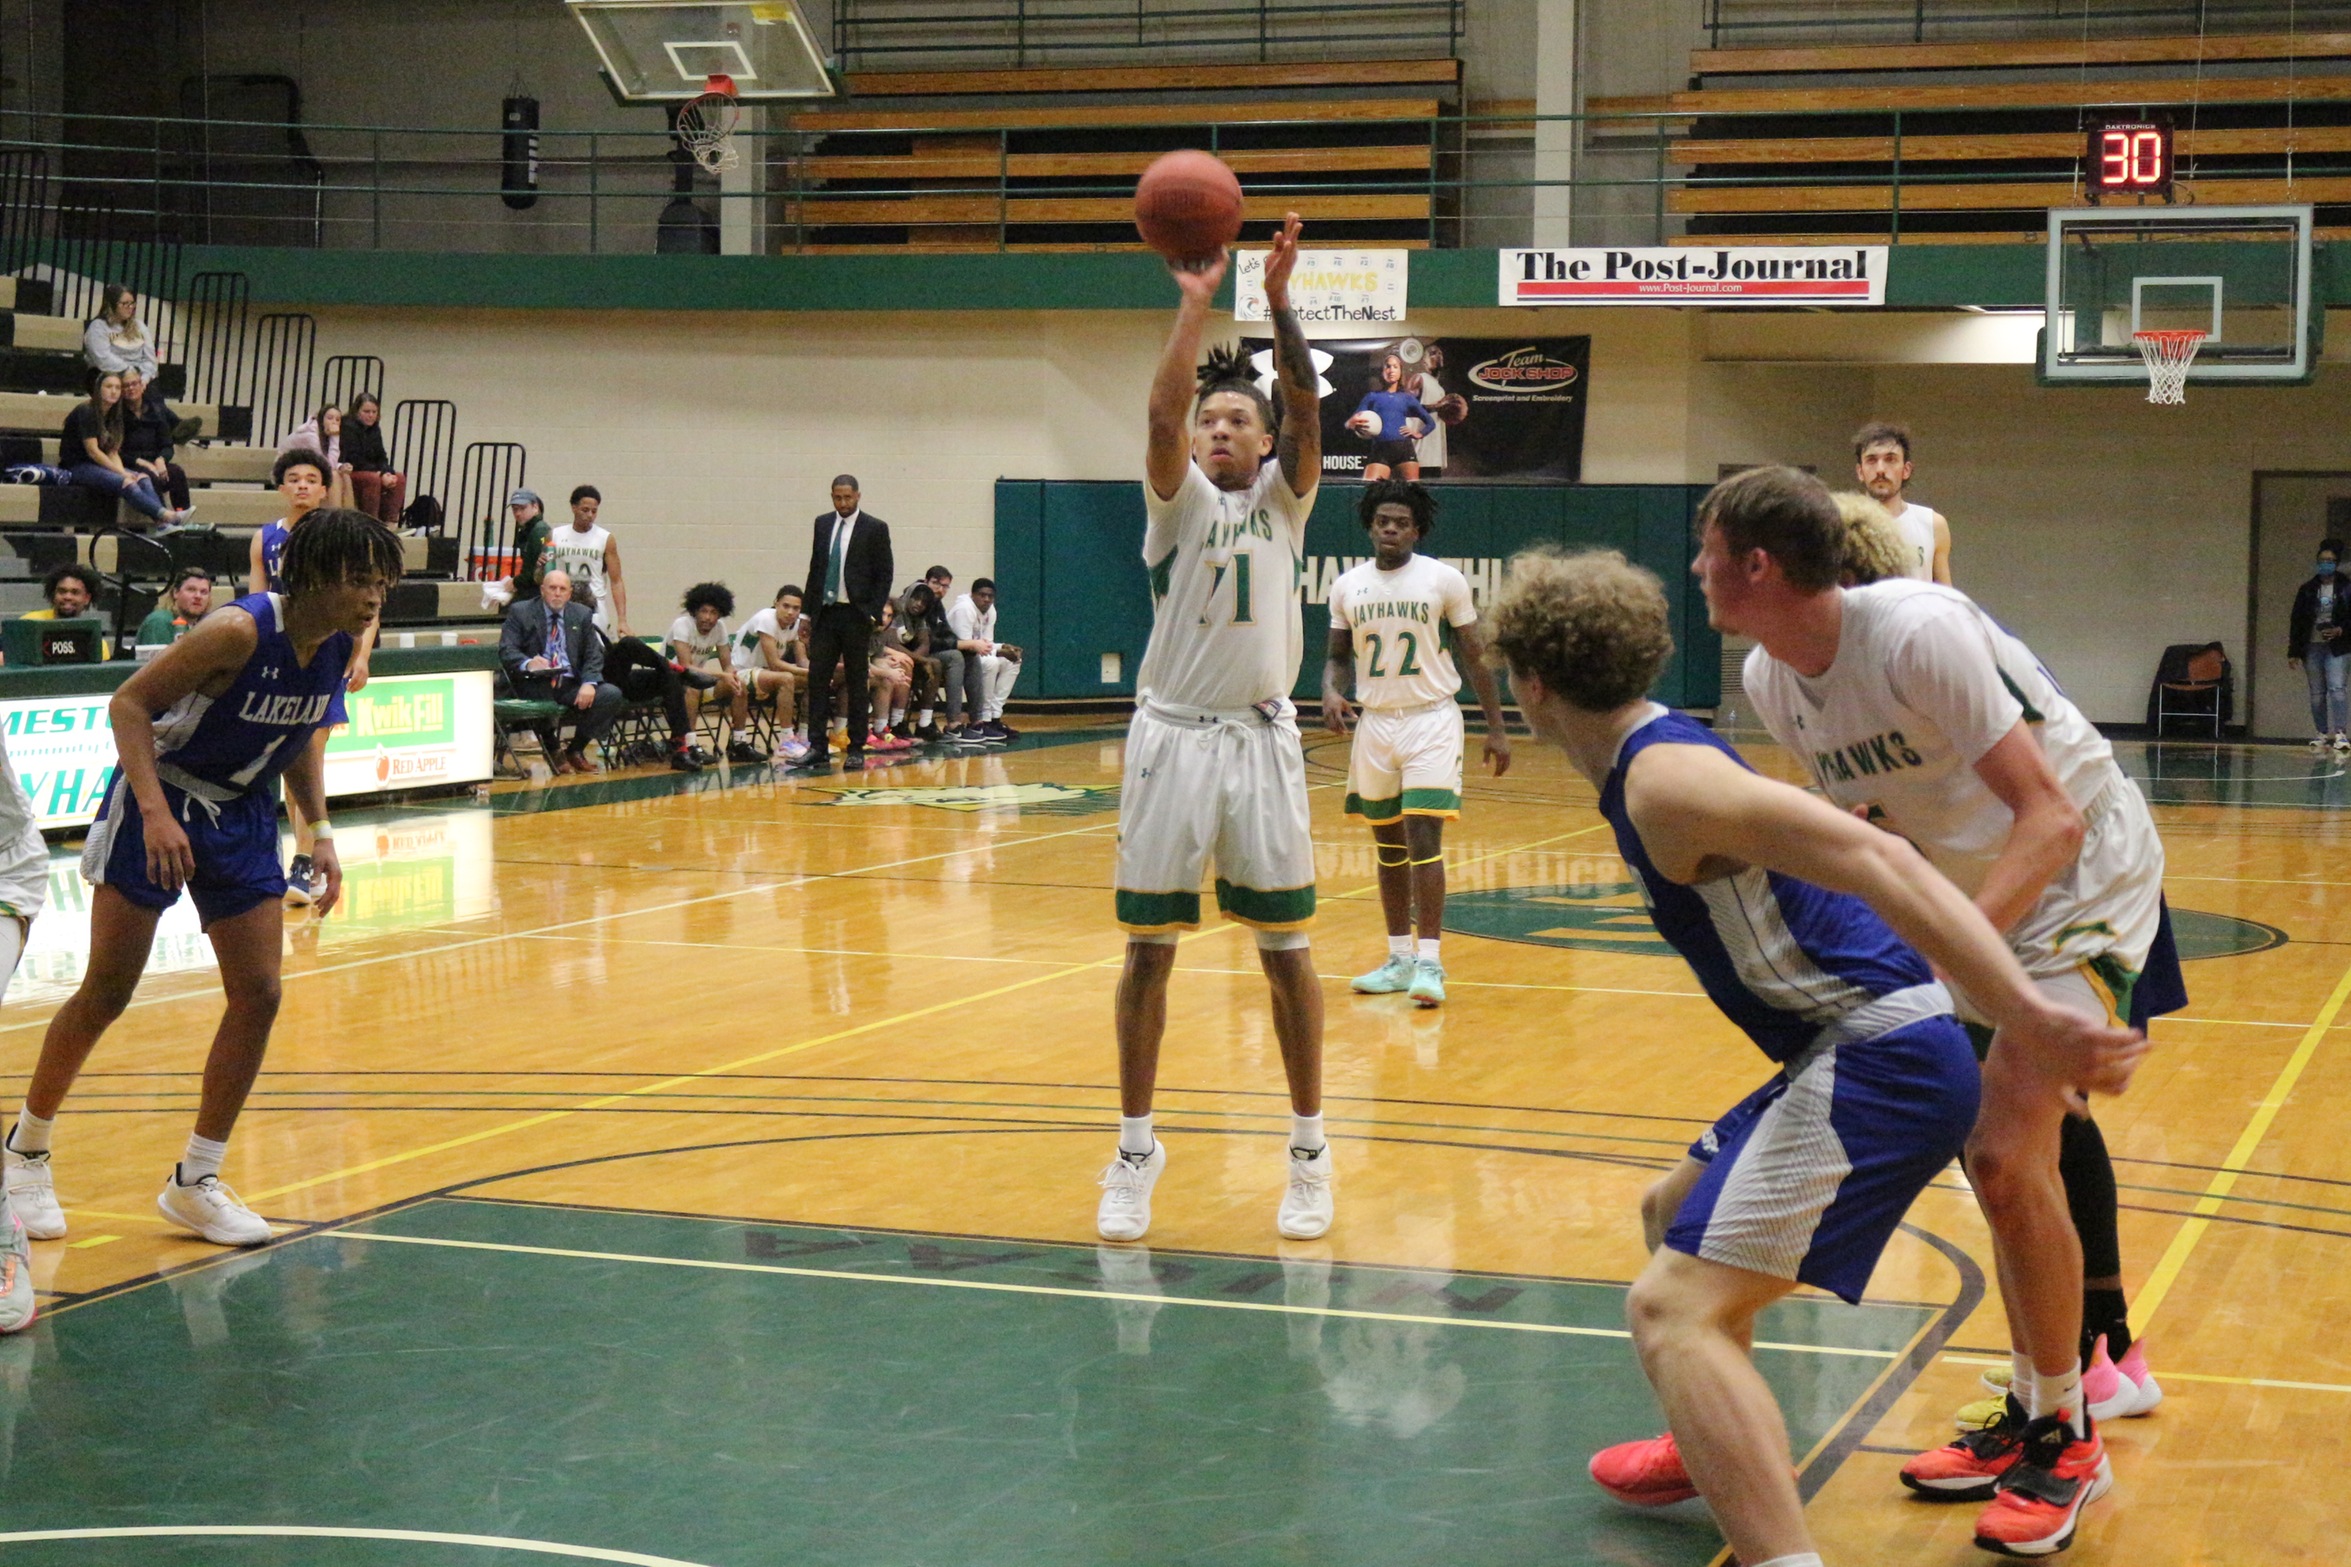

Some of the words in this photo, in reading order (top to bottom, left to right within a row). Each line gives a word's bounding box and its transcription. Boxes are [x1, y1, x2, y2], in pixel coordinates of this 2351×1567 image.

[2102, 132, 2161, 184] 30
[1517, 252, 1590, 280] The
[1604, 250, 1868, 281] Post-Journal
[1261, 271, 1378, 292] YHAWKS
[1639, 283, 1742, 295] www.Post-Journal.com
[1500, 346, 1543, 370] Team
[1478, 367, 1525, 380] JOCK
[1526, 367, 1575, 379] SHOP
[1473, 394, 1515, 403] Screenprint
[1532, 394, 1573, 402] Embroidery
[1353, 602, 1429, 628] JAYHAWKS
[52, 641, 76, 654] POSS.
[1365, 631, 1421, 677] 22
[228, 734, 288, 785] 1
[393, 758, 413, 775] RED
[416, 757, 446, 772] APPLE
